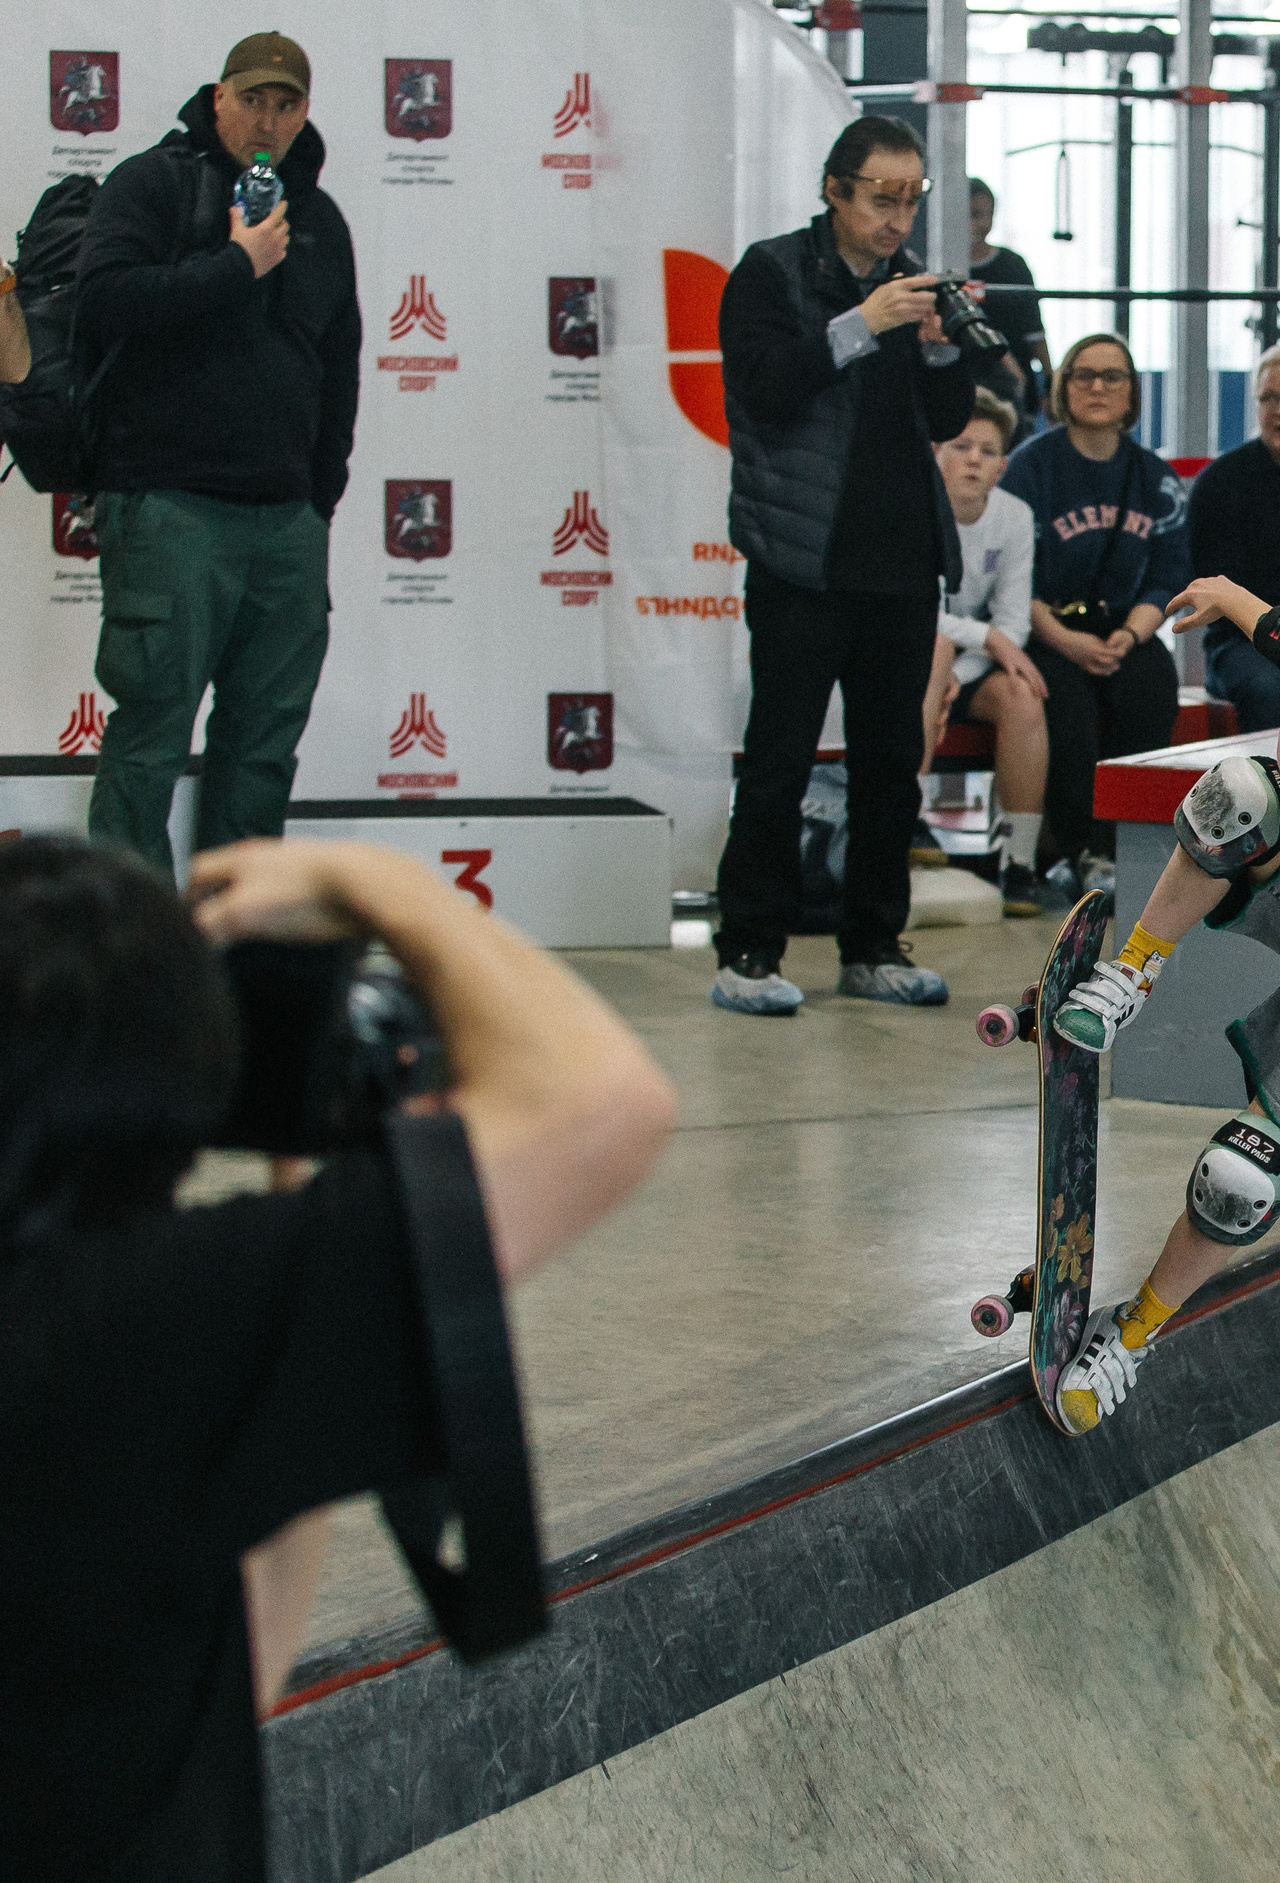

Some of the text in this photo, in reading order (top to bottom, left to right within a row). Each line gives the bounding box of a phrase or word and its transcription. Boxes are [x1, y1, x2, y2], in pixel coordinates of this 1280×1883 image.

[1052, 503, 1153, 540] ELEMNT
[442, 849, 494, 913] 3
[1227, 1135, 1271, 1164] KILLER PADS
[1236, 1128, 1275, 1154] 187
